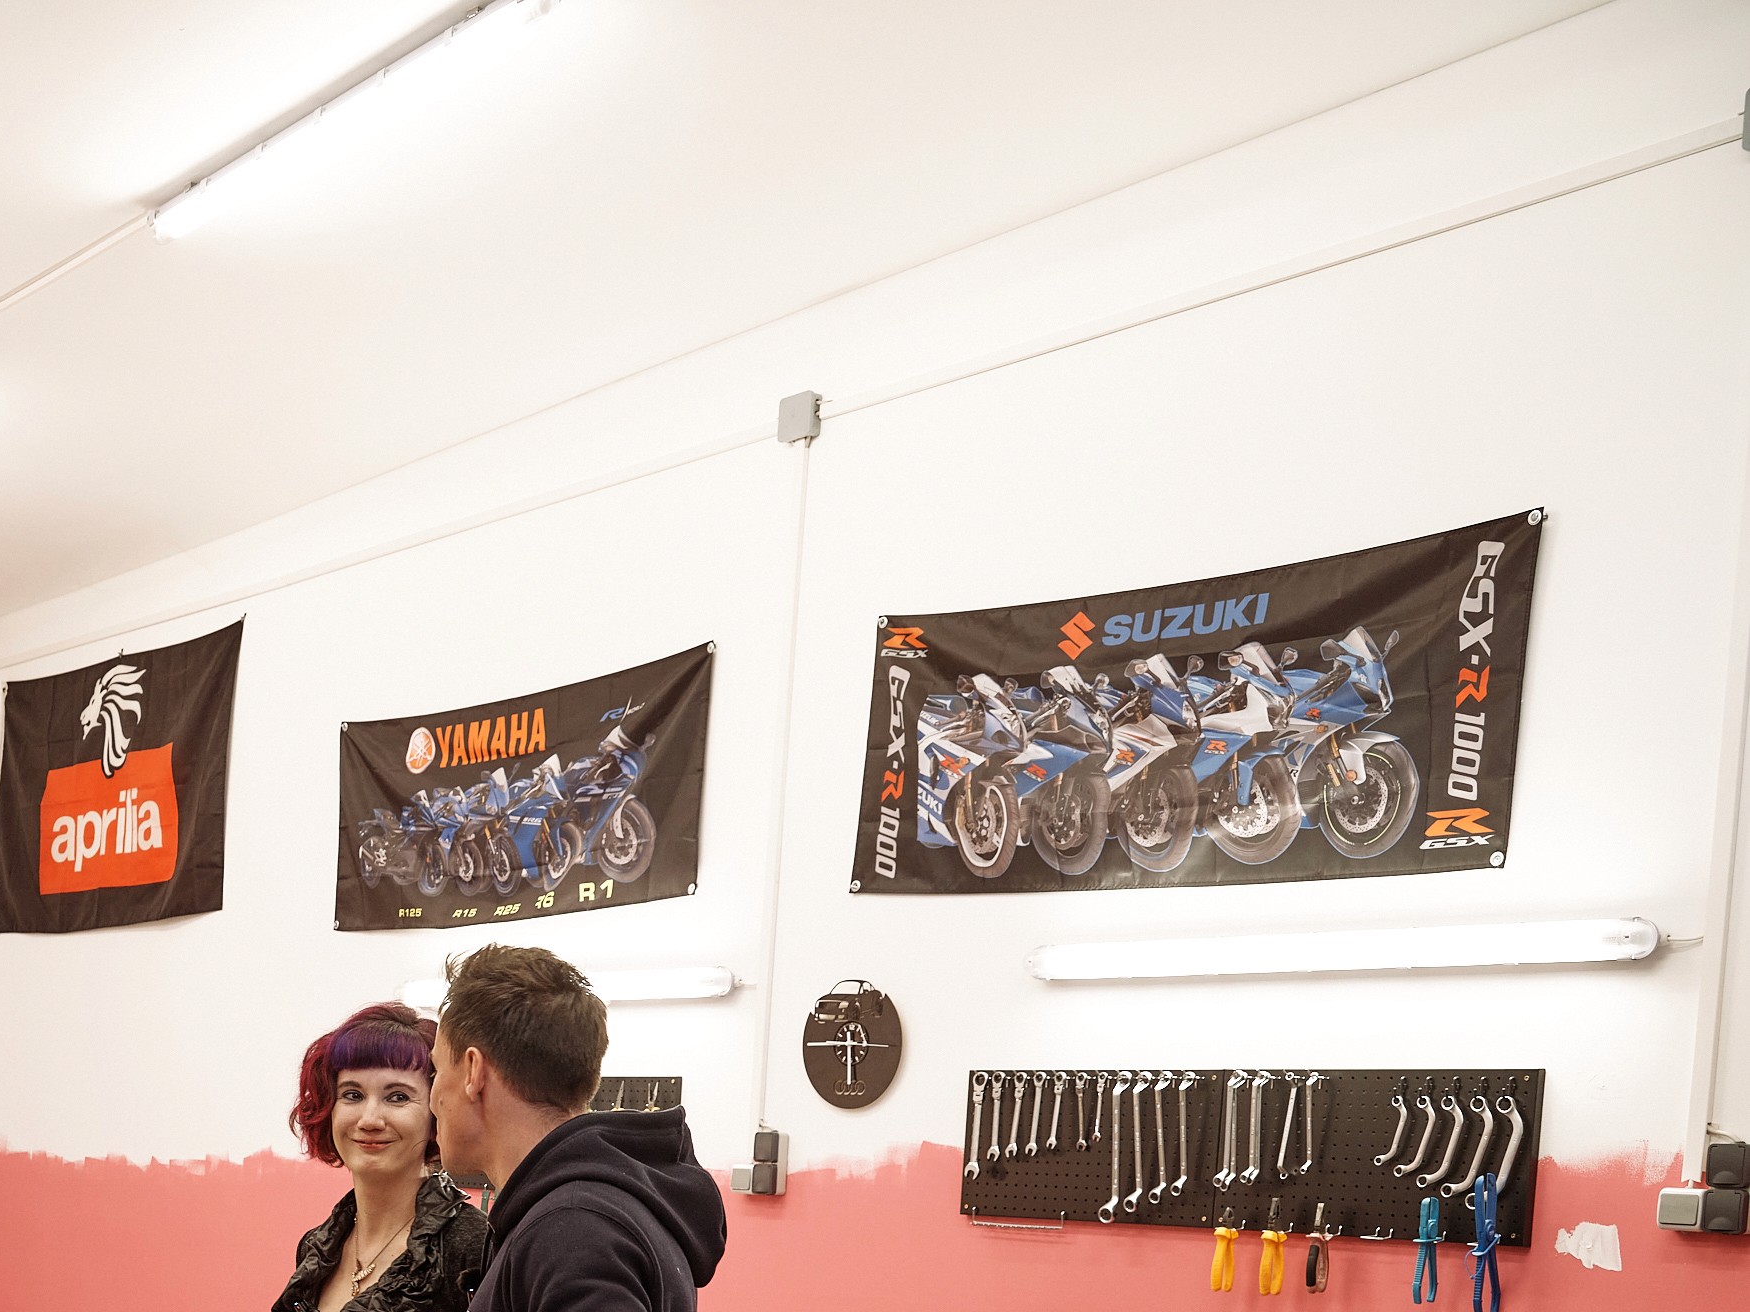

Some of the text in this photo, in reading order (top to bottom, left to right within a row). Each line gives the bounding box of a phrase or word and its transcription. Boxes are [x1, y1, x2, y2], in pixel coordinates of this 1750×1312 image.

[1101, 592, 1270, 647] SUZUKI
[880, 648, 929, 659] GSX
[435, 707, 547, 768] YAMAHA
[50, 787, 163, 873] aprilia
[1418, 834, 1496, 850] GSX
[398, 907, 423, 918] R125
[452, 908, 478, 918] R15
[493, 903, 522, 917] R25
